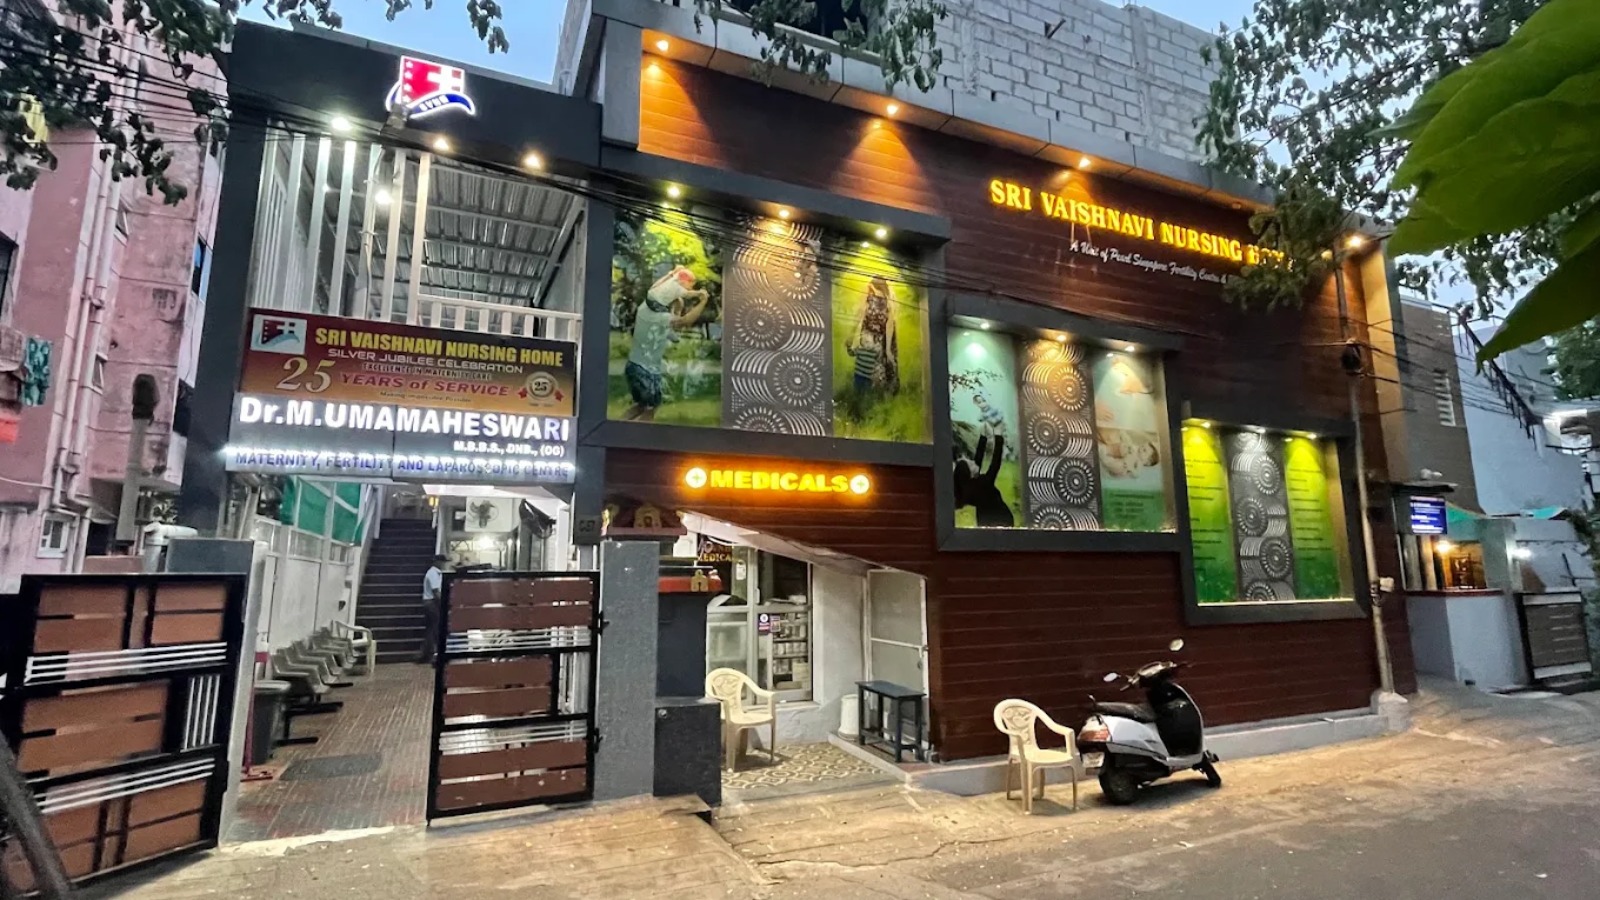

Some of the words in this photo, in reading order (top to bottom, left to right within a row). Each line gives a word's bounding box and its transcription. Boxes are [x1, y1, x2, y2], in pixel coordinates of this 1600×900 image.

[990, 179, 1032, 211] SRI
[1039, 191, 1155, 240] VAISHNAVI
[1160, 221, 1243, 262] NURSING
[1080, 242, 1100, 257] Unit
[1100, 248, 1108, 262] of
[1133, 254, 1168, 272] Singapore
[315, 327, 346, 346] SRI
[350, 331, 443, 355] VAISHNAVI
[446, 341, 517, 363] NURSING
[520, 349, 563, 367] HOME
[328, 348, 376, 361] SILVER
[379, 353, 434, 366] JUBILEE
[437, 359, 523, 374] CELEBRATION
[425, 368, 471, 379] MATERNITY
[275, 357, 336, 393] 25
[341, 373, 403, 388] YEARS
[409, 379, 427, 390] of
[434, 381, 509, 397] SERVICE
[534, 381, 548, 391] 25
[235, 450, 321, 471] MATERNITY,
[325, 454, 393, 469] FERTILITY
[397, 458, 424, 471] AND
[524, 462, 569, 477] CENTRE
[710, 470, 849, 493] MEDICALS
